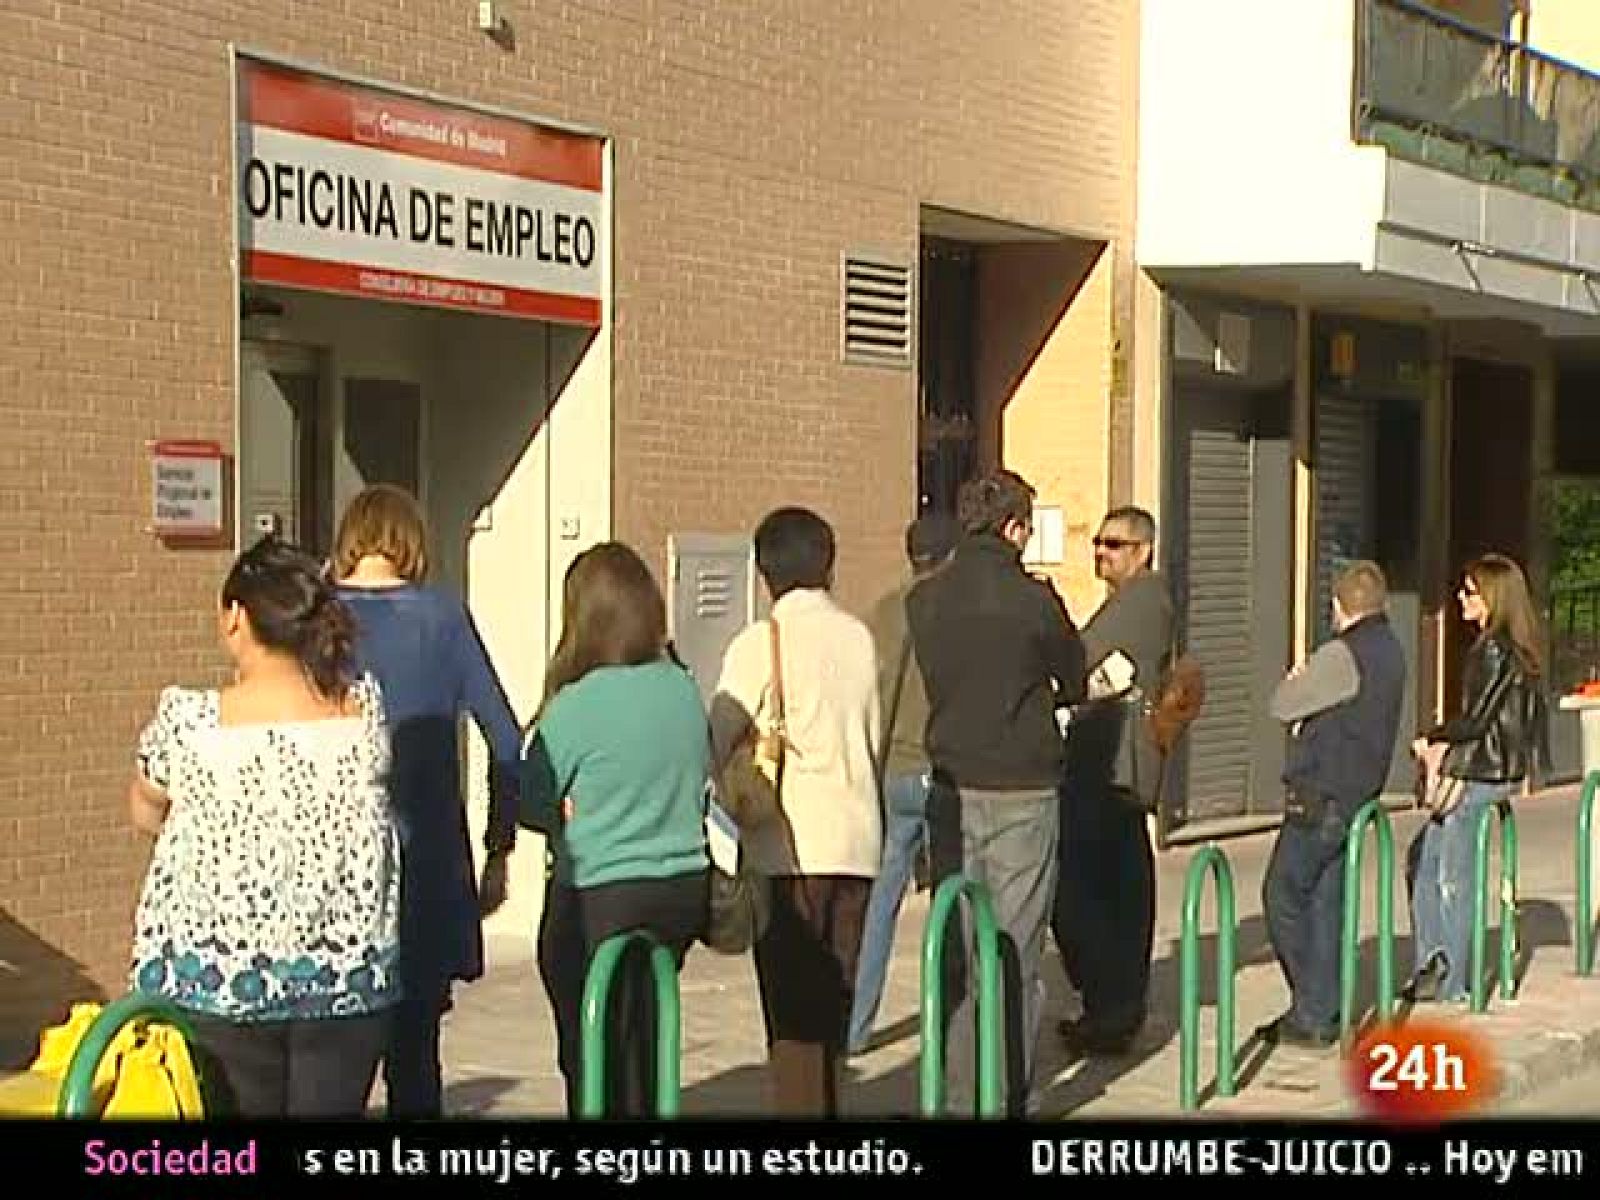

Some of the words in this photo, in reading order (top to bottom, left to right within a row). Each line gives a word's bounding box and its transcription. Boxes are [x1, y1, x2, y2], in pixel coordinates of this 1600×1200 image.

[244, 158, 399, 240] OFICINA
[409, 188, 455, 247] DE
[466, 197, 596, 268] EMPLEO
